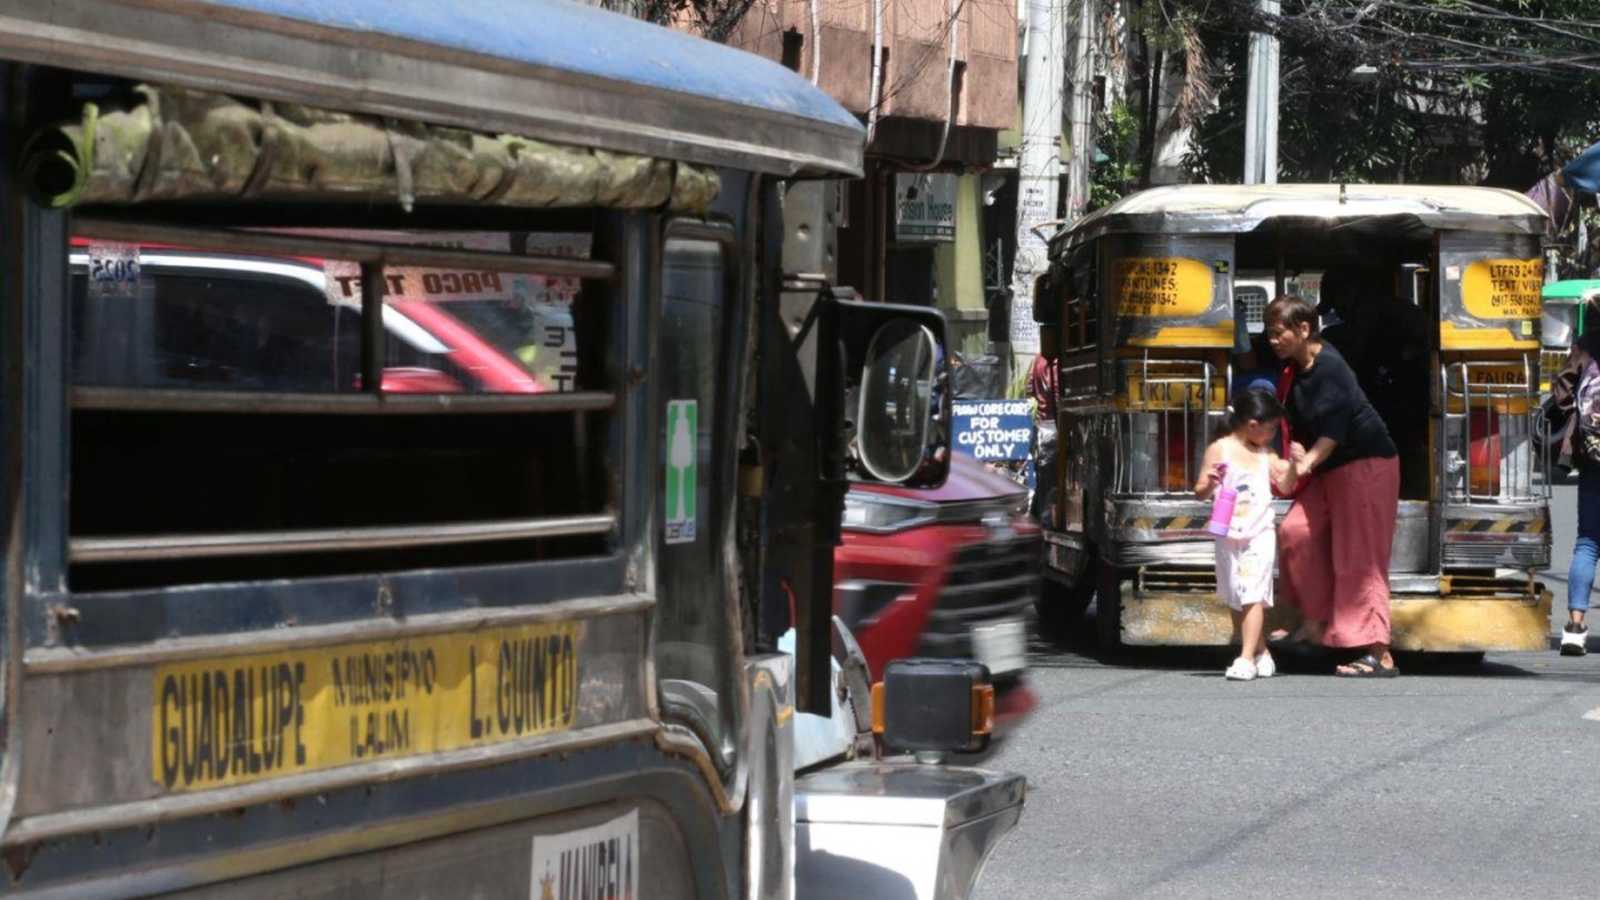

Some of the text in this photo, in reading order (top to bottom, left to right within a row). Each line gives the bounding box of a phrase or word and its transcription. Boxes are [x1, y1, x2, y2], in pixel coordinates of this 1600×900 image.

[970, 417, 999, 429] FOR
[958, 428, 1030, 446] CUSTOMER
[974, 444, 1015, 458] ONLY
[160, 661, 307, 788] GUADALUPE
[499, 633, 574, 734] GUINTO
